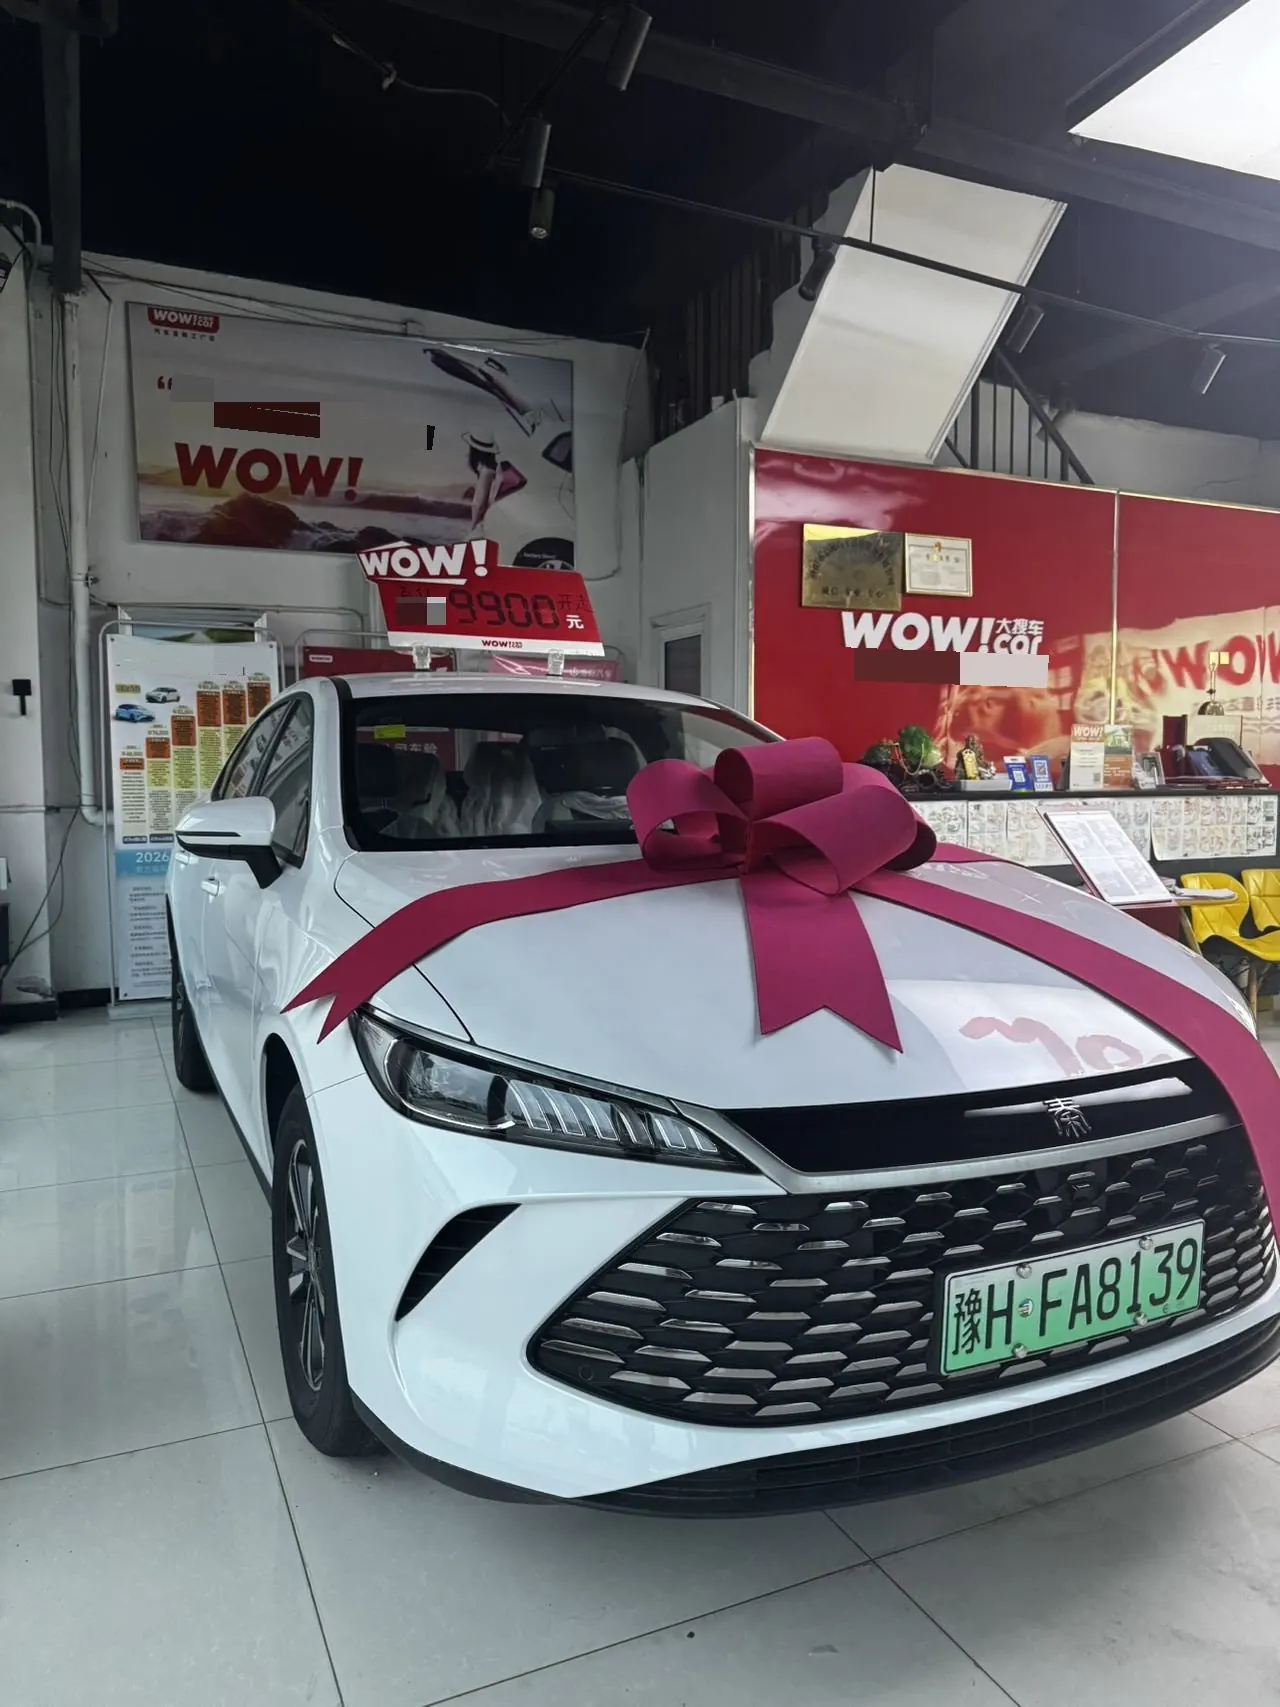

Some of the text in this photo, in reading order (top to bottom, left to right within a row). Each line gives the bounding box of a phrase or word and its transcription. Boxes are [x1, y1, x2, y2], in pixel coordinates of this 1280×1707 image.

[153, 308, 198, 326] WOW!
[175, 442, 364, 502] WOW!
[359, 539, 489, 578] WOW!
[448, 588, 561, 630] 9900
[565, 614, 585, 630] 元
[841, 611, 996, 654] WOW!
[995, 618, 1045, 636] 大搜车
[481, 639, 511, 649] WOW!
[992, 633, 1044, 655] car
[135, 851, 170, 863] 2026
[952, 1237, 1199, 1356] 豫H FA8139
